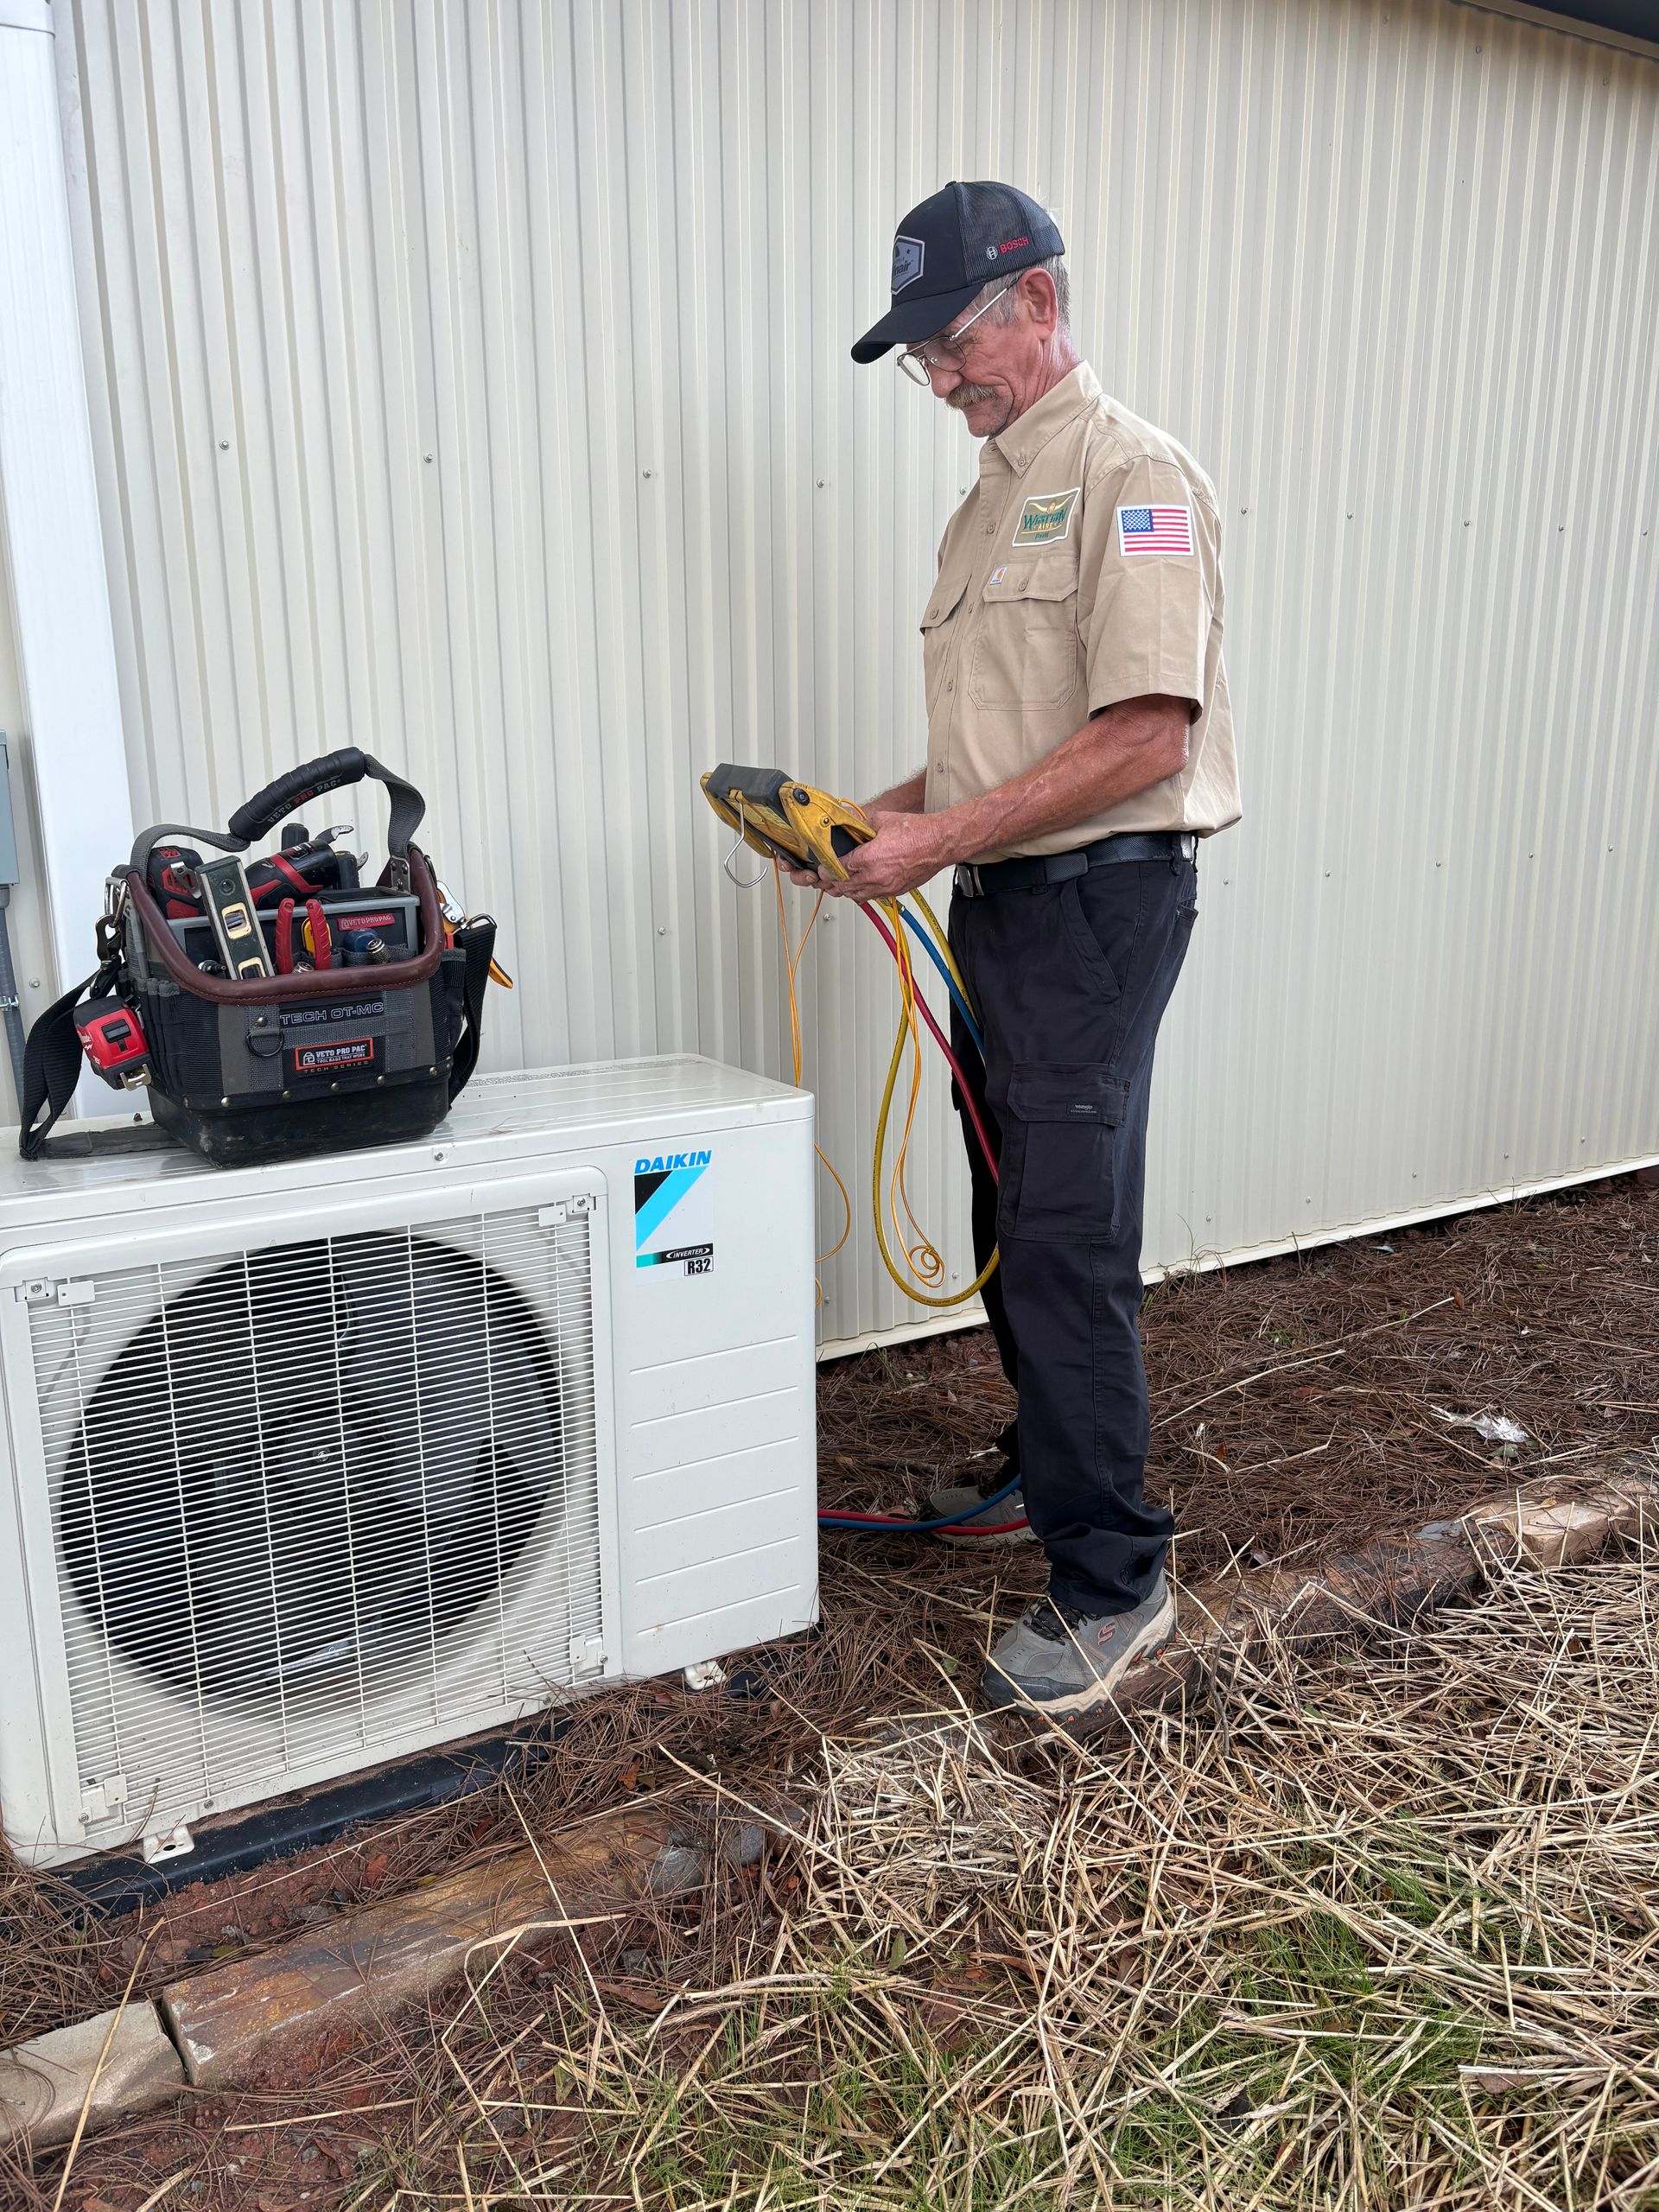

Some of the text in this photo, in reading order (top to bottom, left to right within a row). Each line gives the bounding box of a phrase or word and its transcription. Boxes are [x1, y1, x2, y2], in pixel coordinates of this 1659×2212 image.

[999, 236, 1029, 254] BOSCH
[267, 803, 292, 823] VETO
[293, 790, 315, 804] PRO
[348, 918, 365, 926] VETO
[280, 1002, 384, 1025] TECH OT-MC
[336, 1047, 351, 1056] PRO
[334, 1061, 369, 1070] SERIES
[634, 1150, 712, 1174] DAIKIN
[672, 1248, 703, 1259] INVERTER
[687, 1258, 711, 1275] R32
